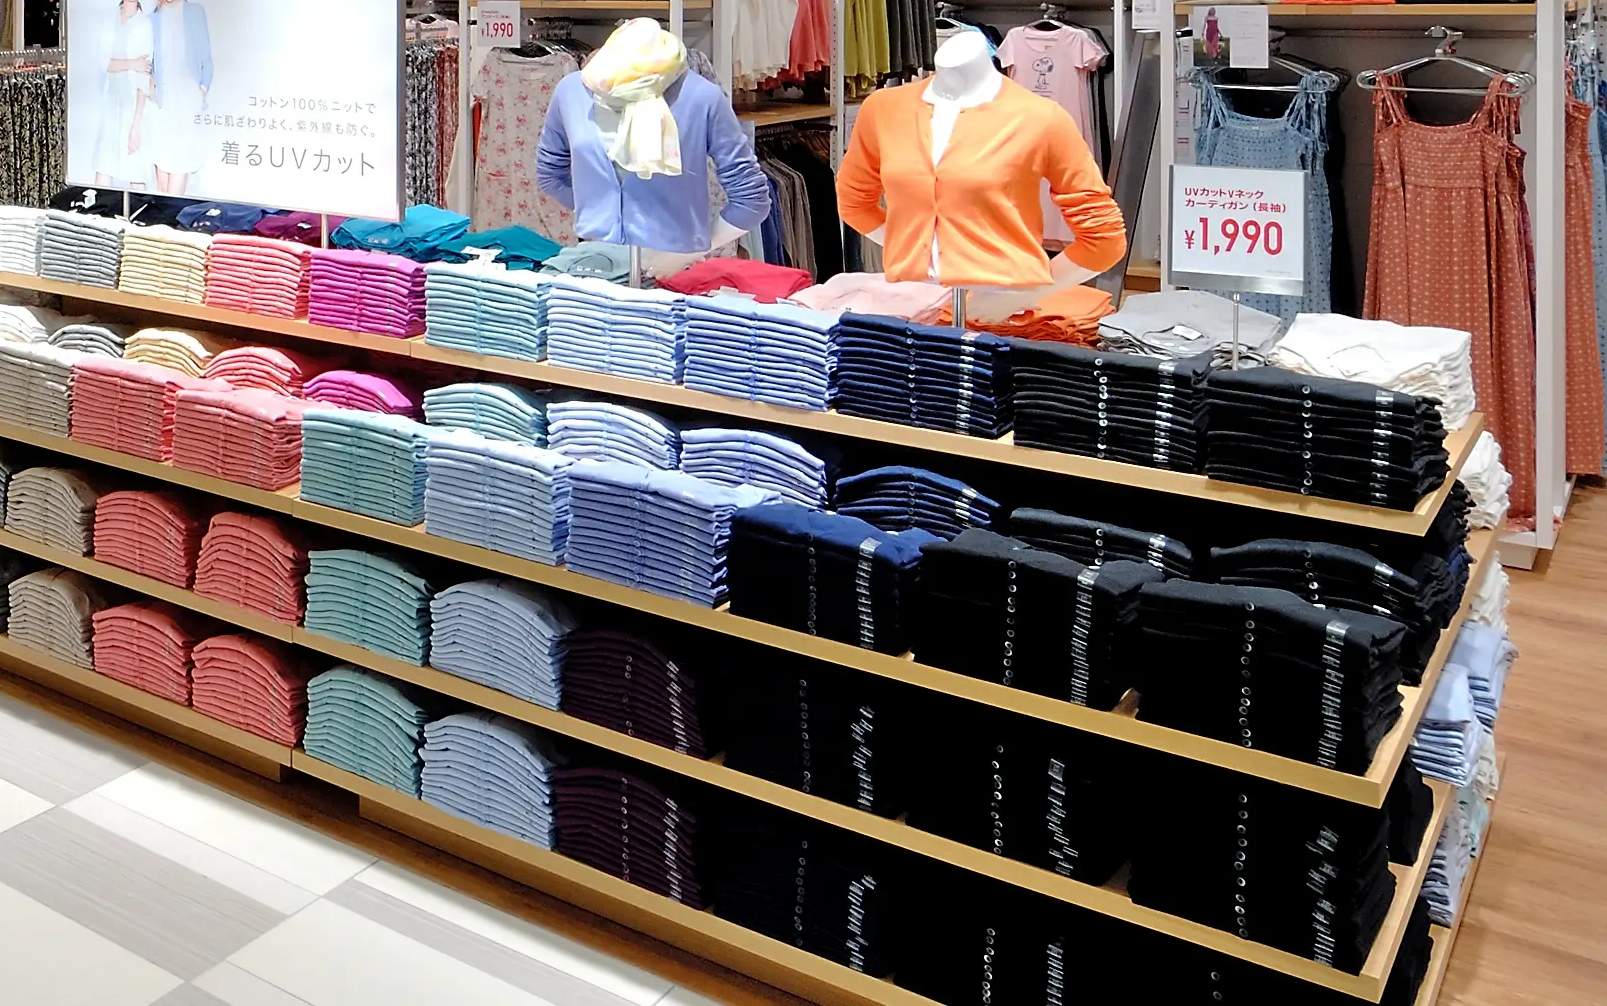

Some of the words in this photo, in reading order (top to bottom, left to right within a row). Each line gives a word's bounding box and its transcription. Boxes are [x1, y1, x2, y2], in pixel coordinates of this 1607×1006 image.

[248, 95, 376, 115] コットン100%ニットで
[221, 140, 375, 177] 着るUVカット
[1184, 187, 1265, 200] UVカットVネック
[1184, 216, 1284, 256] ¥1,990
